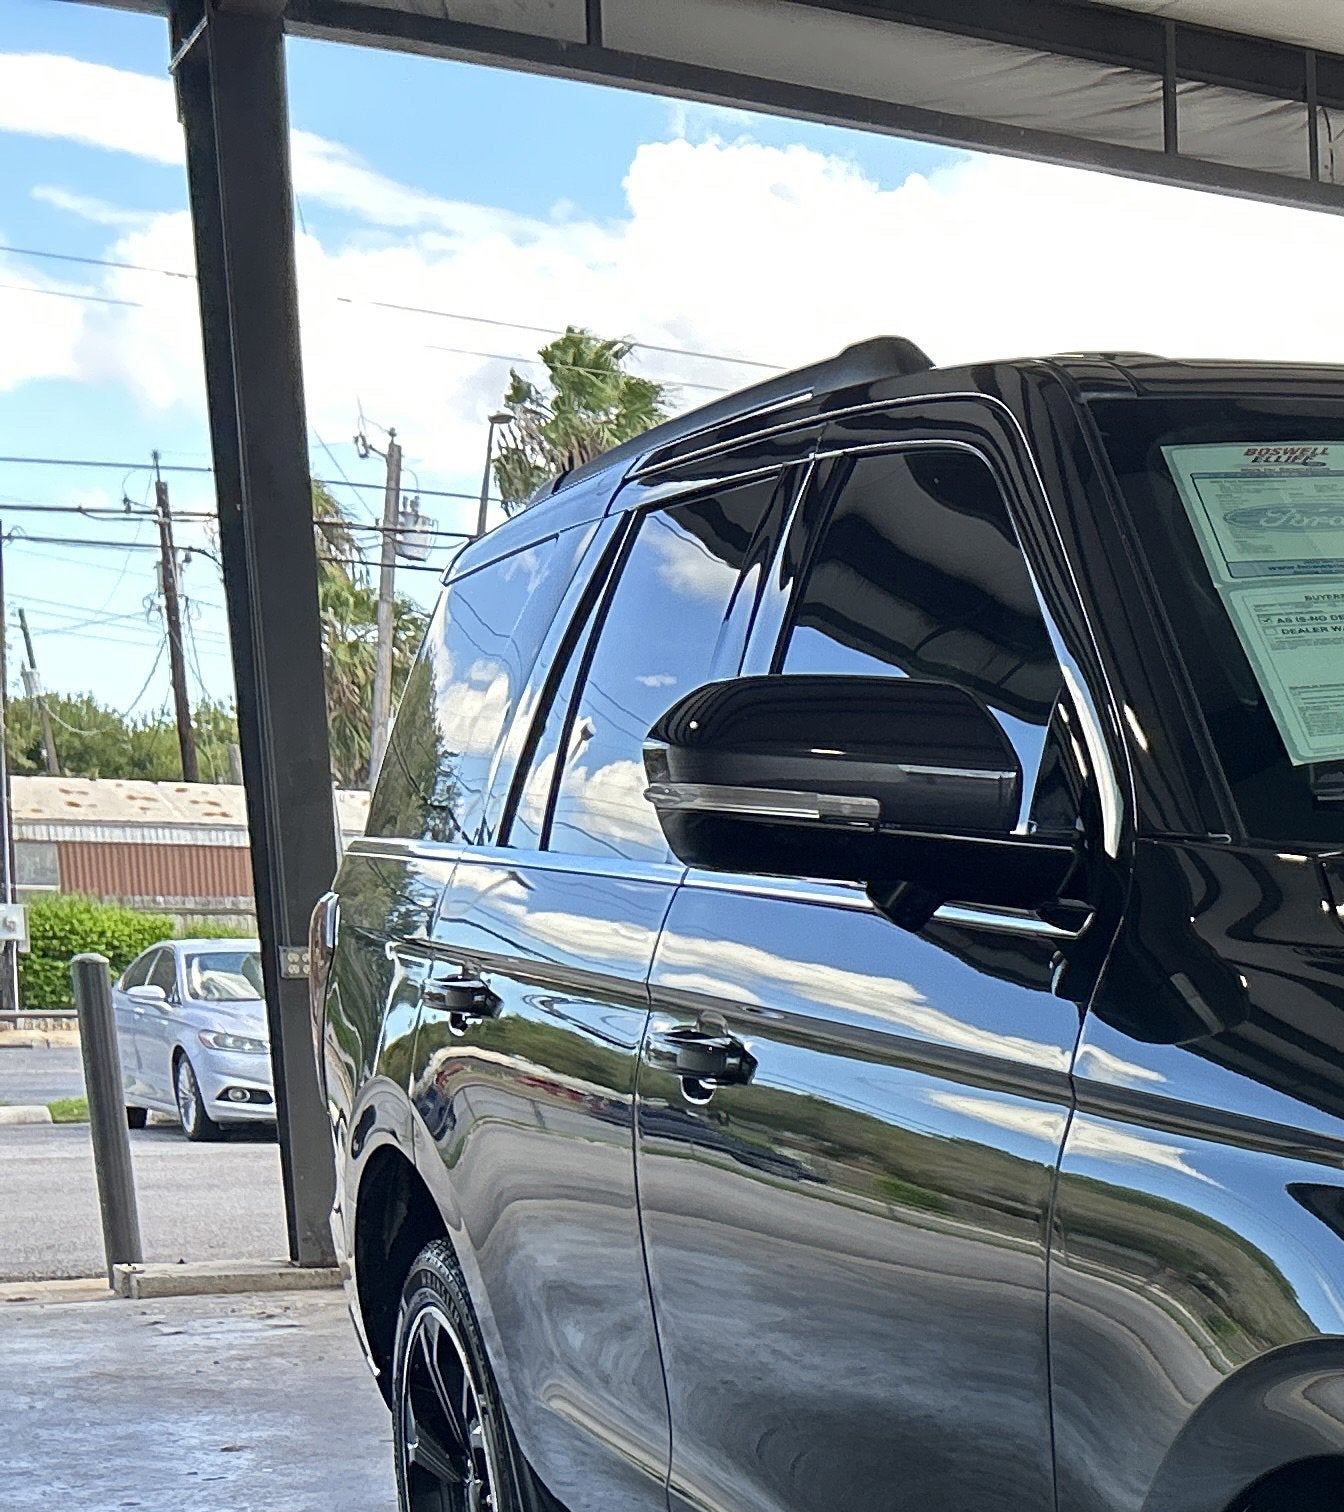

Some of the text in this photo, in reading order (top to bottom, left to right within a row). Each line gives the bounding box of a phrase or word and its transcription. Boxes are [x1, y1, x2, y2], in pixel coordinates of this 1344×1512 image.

[1244, 447, 1329, 456] BOSWELL
[1276, 616, 1293, 624] AS
[1281, 625, 1330, 635] DEALER
